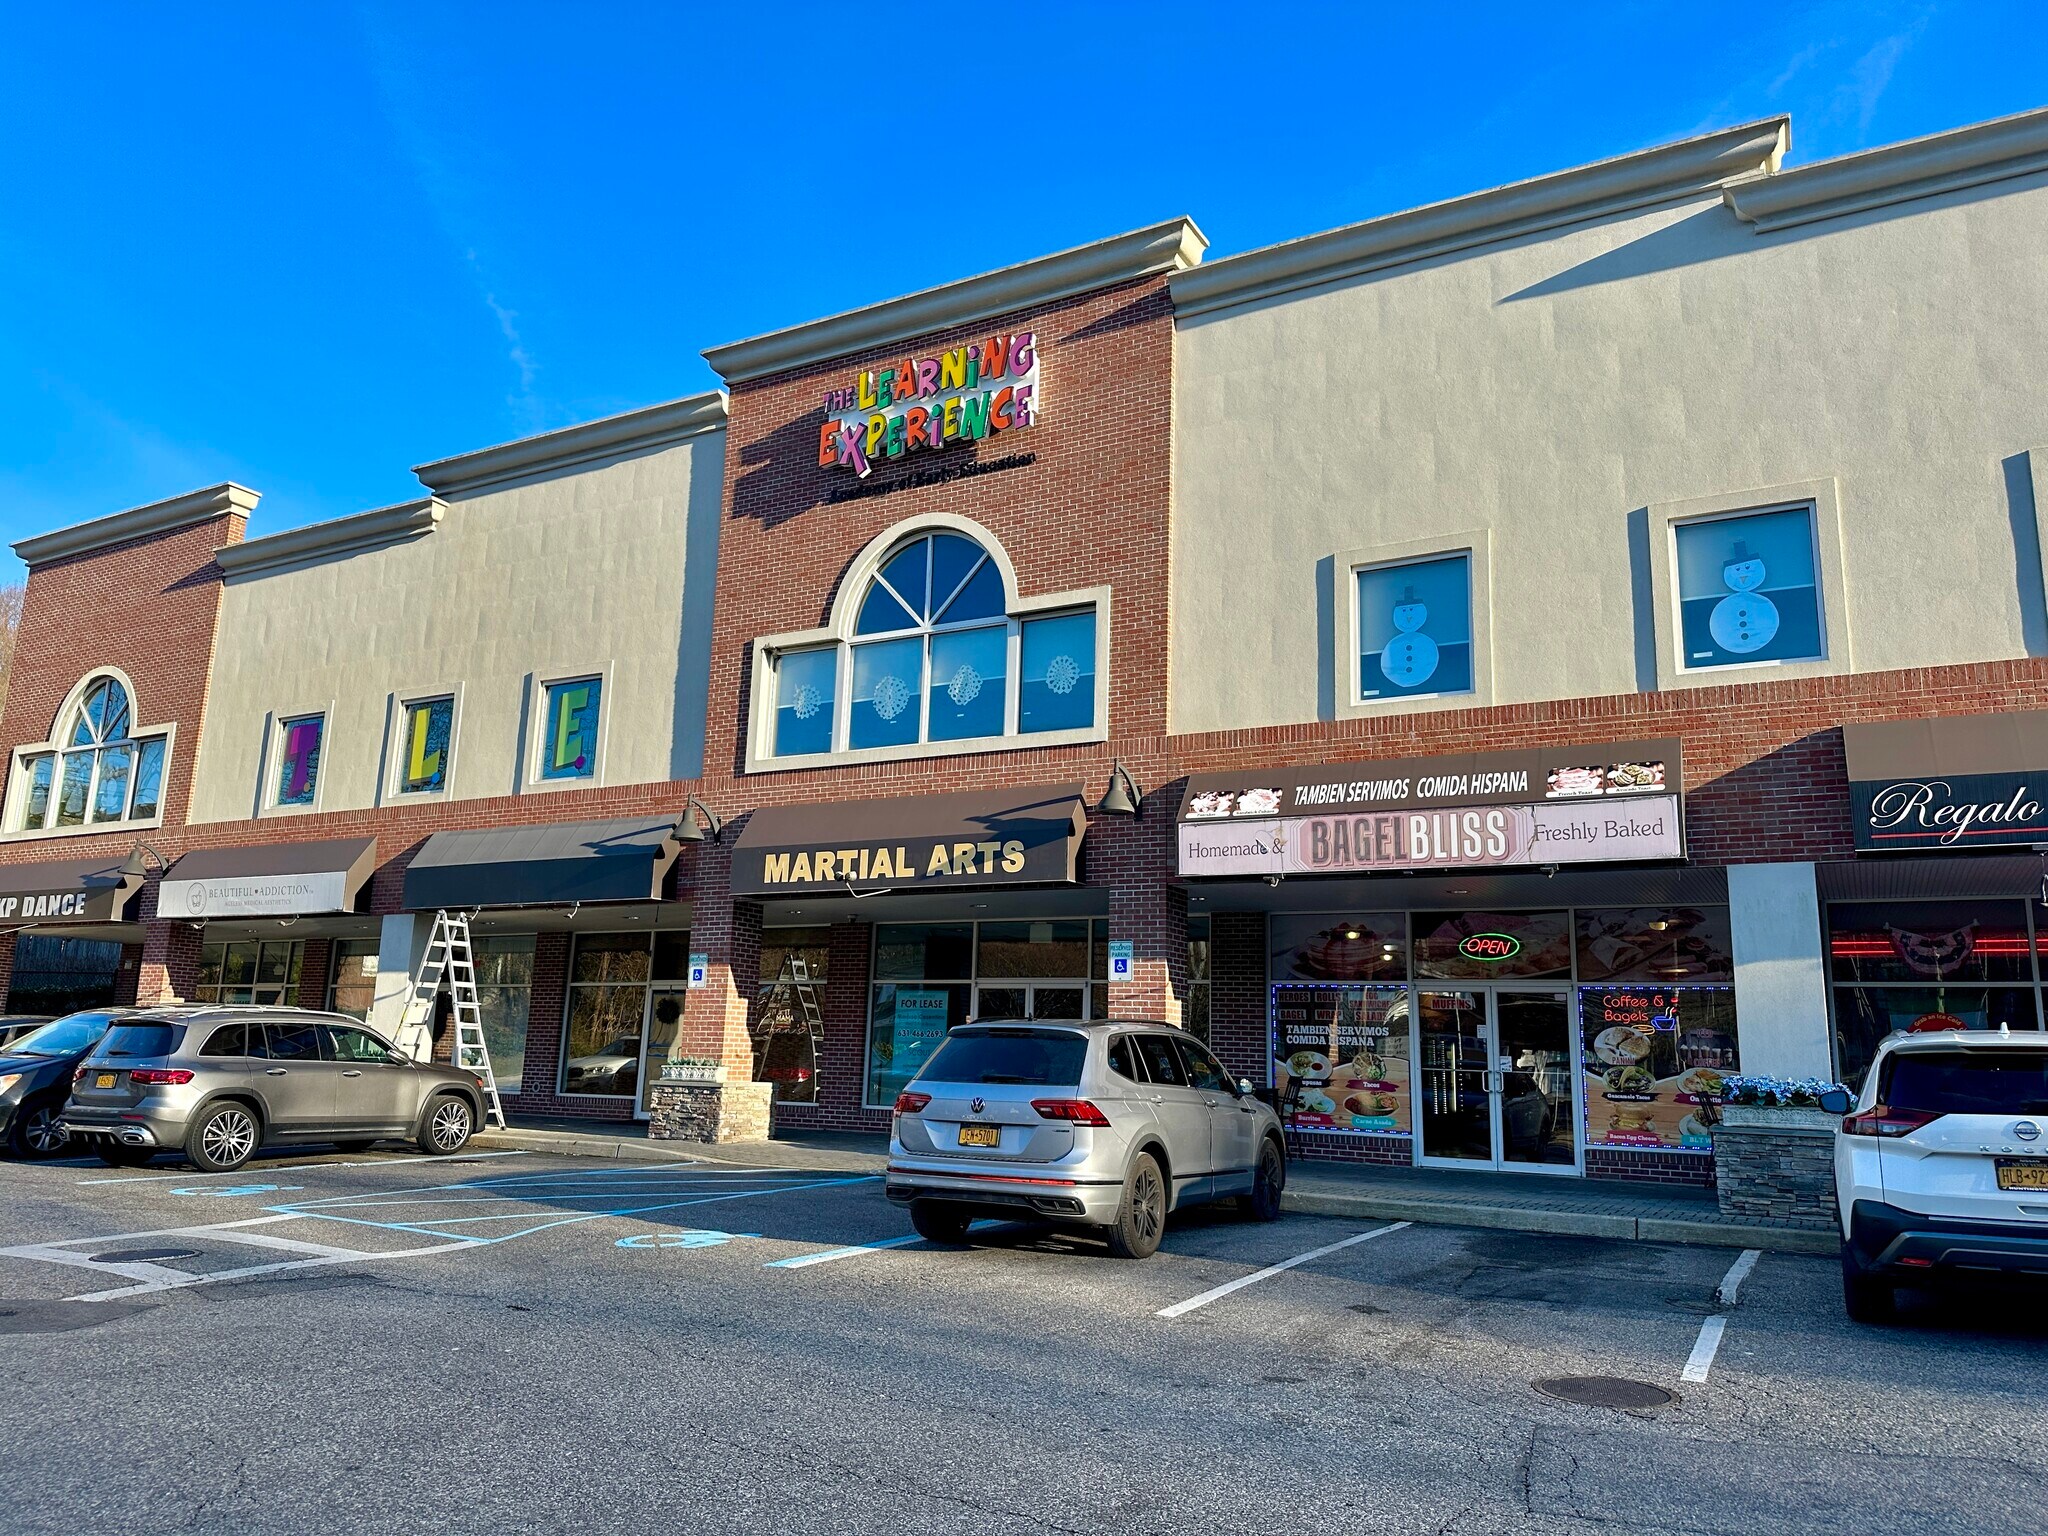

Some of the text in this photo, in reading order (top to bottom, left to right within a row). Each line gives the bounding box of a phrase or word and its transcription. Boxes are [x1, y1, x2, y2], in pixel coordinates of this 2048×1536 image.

[823, 386, 855, 414] THE
[1294, 770, 1529, 805] TAMBIEN SERVIMOS COMIDA HISPANA
[1869, 781, 2045, 845] Regalo
[1534, 817, 1665, 843] Freshly Baked
[1272, 837, 1285, 854] &
[763, 840, 1026, 884] MARTIAL ARTS
[21, 893, 87, 918] DANCE
[1467, 938, 1511, 955] OPEN
[900, 999, 943, 1008] FOR LEASE
[1280, 992, 1310, 1002] HEROES
[1603, 995, 1664, 1008] Coffee &
[1280, 1009, 1306, 1020] BAGEL
[1604, 1009, 1649, 1024] Bagels
[1286, 1025, 1390, 1036] TAMBIEN SERVIMOS
[1286, 1035, 1327, 1045] COMIDA
